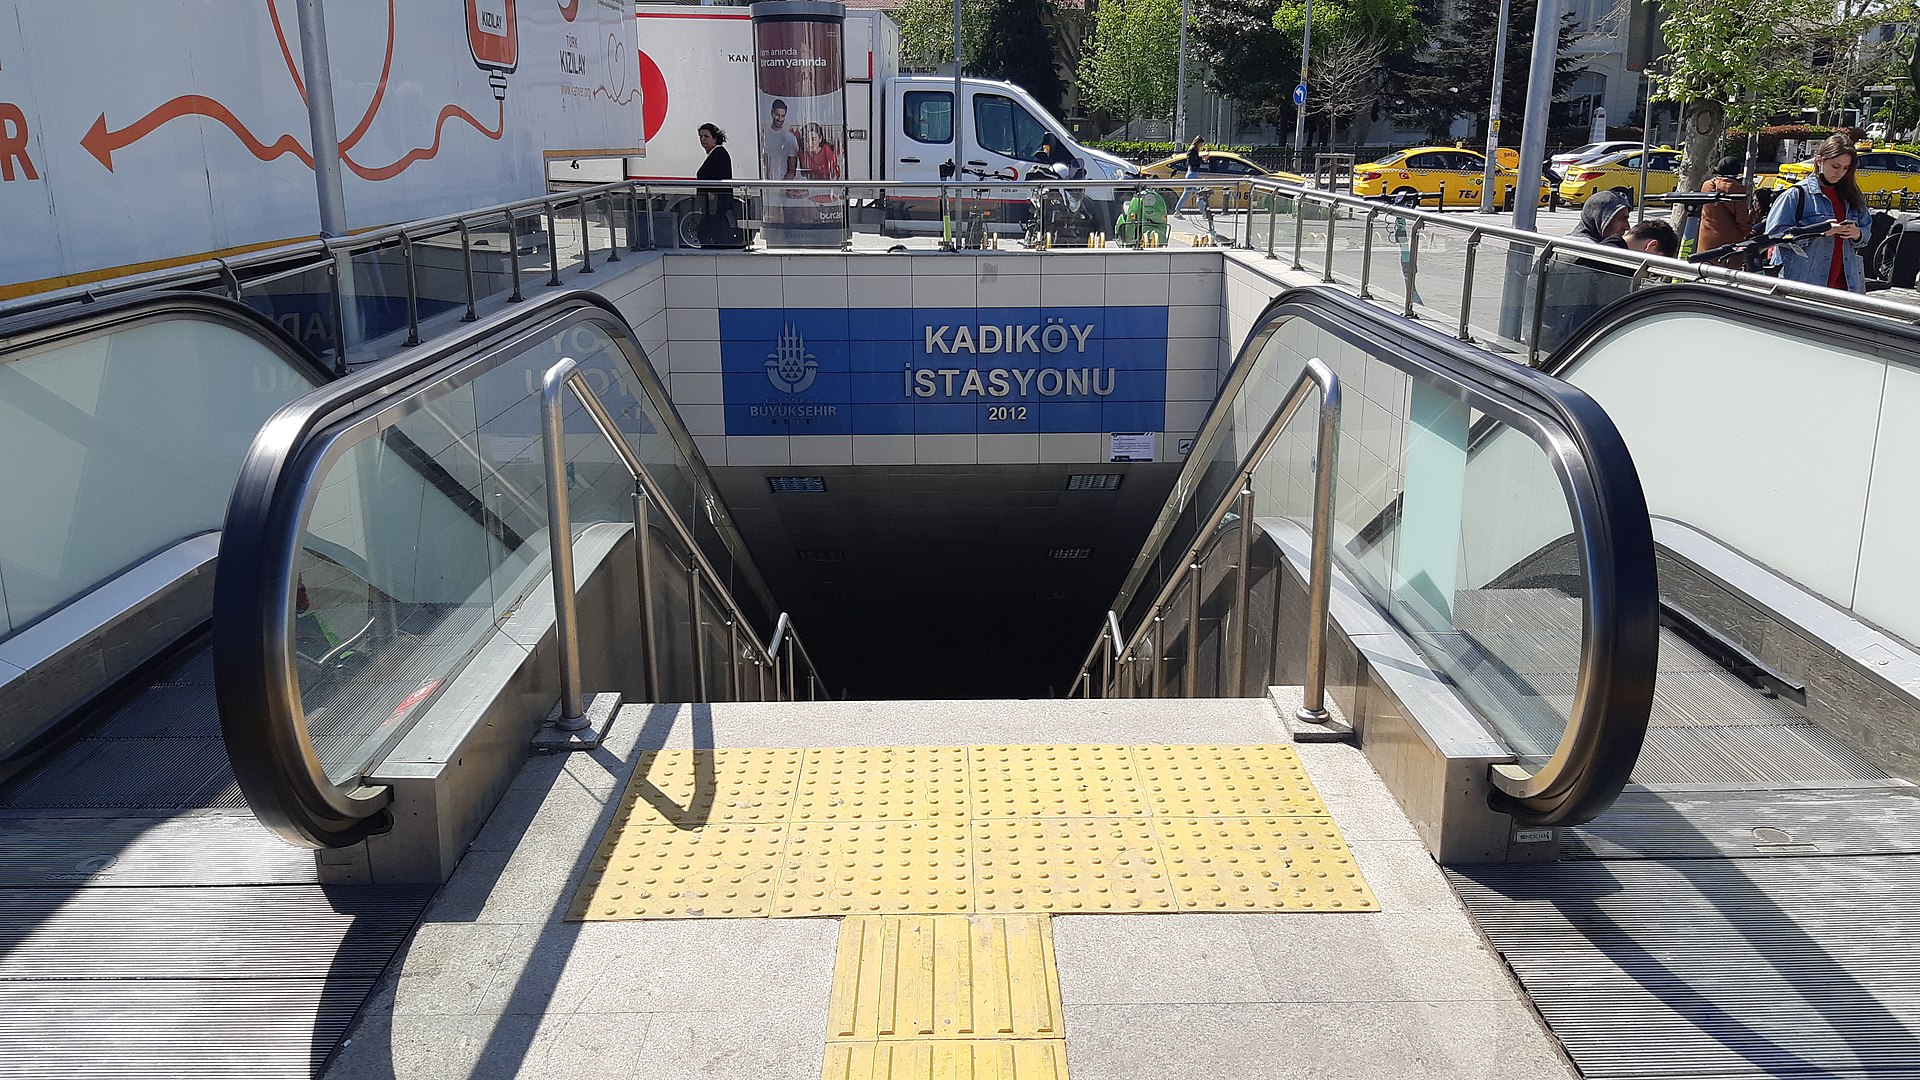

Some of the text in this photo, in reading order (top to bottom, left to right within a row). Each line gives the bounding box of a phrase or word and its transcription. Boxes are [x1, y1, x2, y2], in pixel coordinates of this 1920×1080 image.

[481, 10, 502, 29] KIZILAY
[560, 50, 586, 75] KIZILAY
[728, 54, 748, 62] KAN
[786, 57, 826, 68] yanında
[924, 317, 1094, 354] KADIKÖY
[904, 362, 1115, 398] İSTASYONU
[988, 406, 1027, 420] 2012
